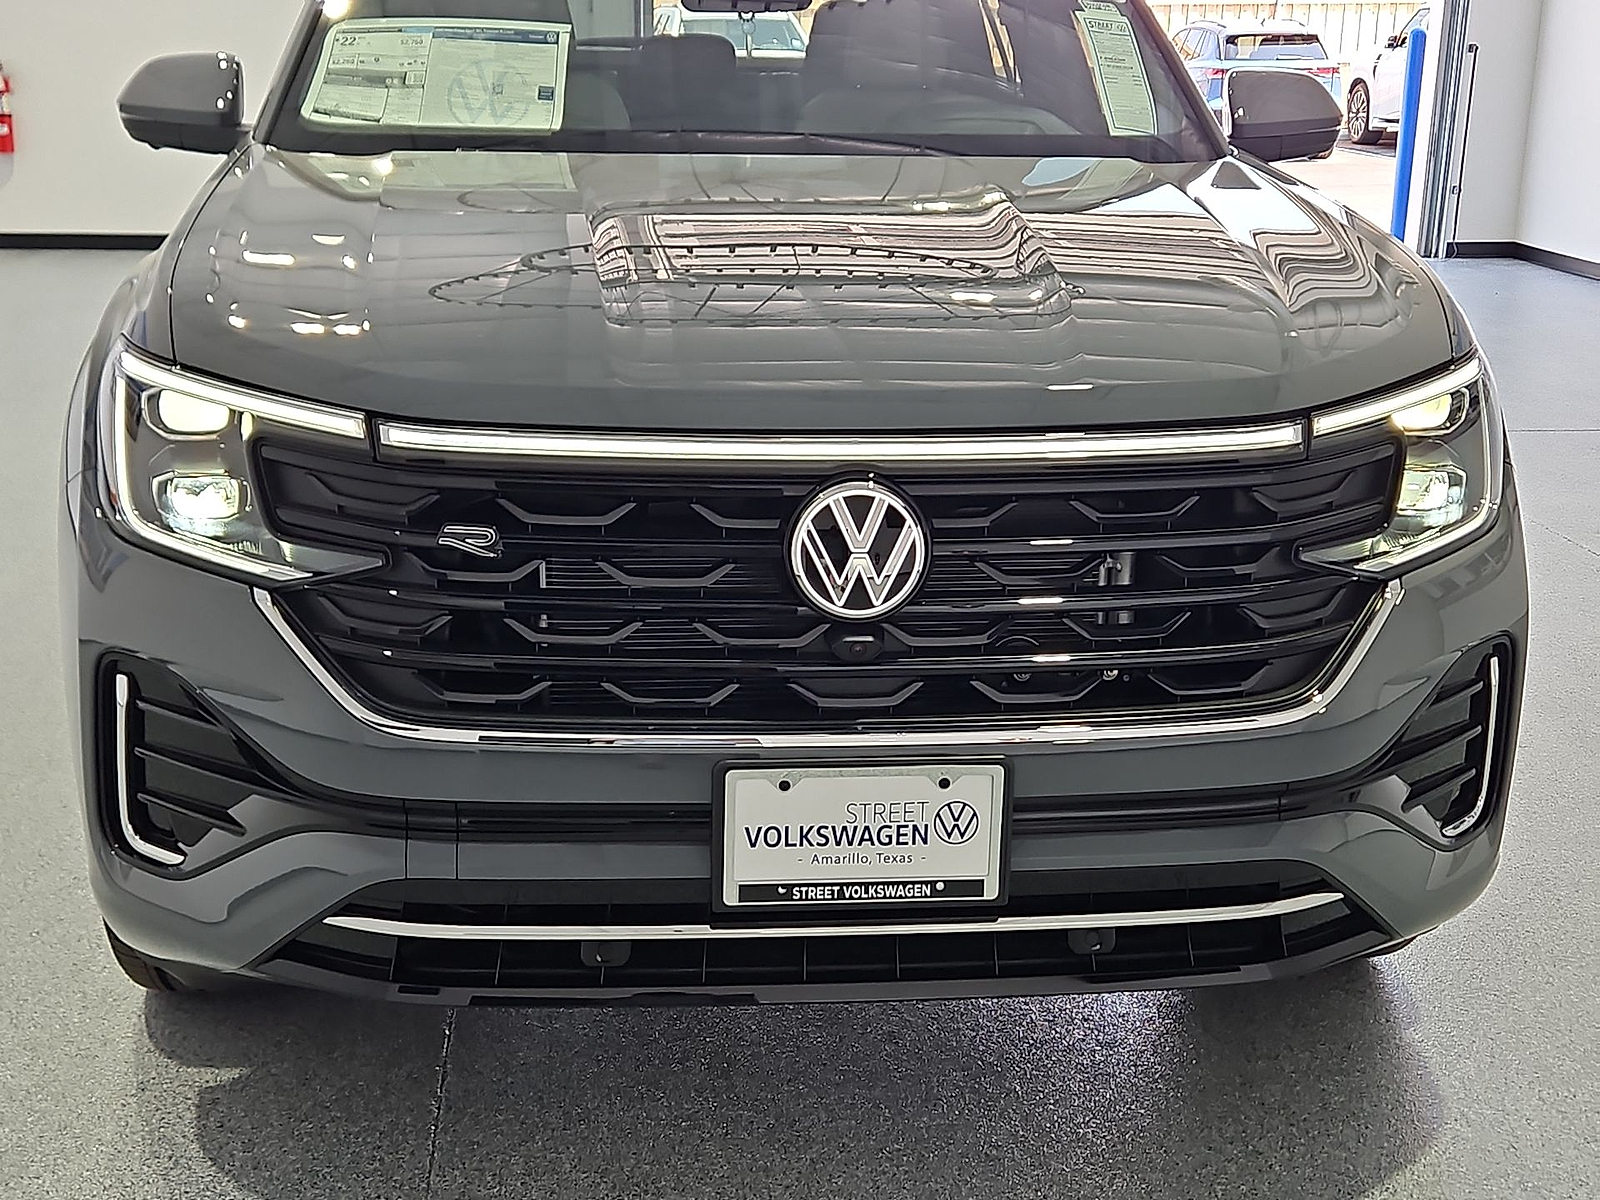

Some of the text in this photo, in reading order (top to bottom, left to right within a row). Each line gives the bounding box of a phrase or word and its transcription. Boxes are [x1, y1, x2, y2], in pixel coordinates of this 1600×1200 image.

[340, 36, 357, 46] 22
[845, 801, 930, 824] STREET
[744, 823, 929, 849] VOLKSWAGEN
[810, 852, 873, 866] Amarillo,
[875, 852, 913, 865] Texas
[792, 883, 931, 900] STREET VOLKSWAGEN
